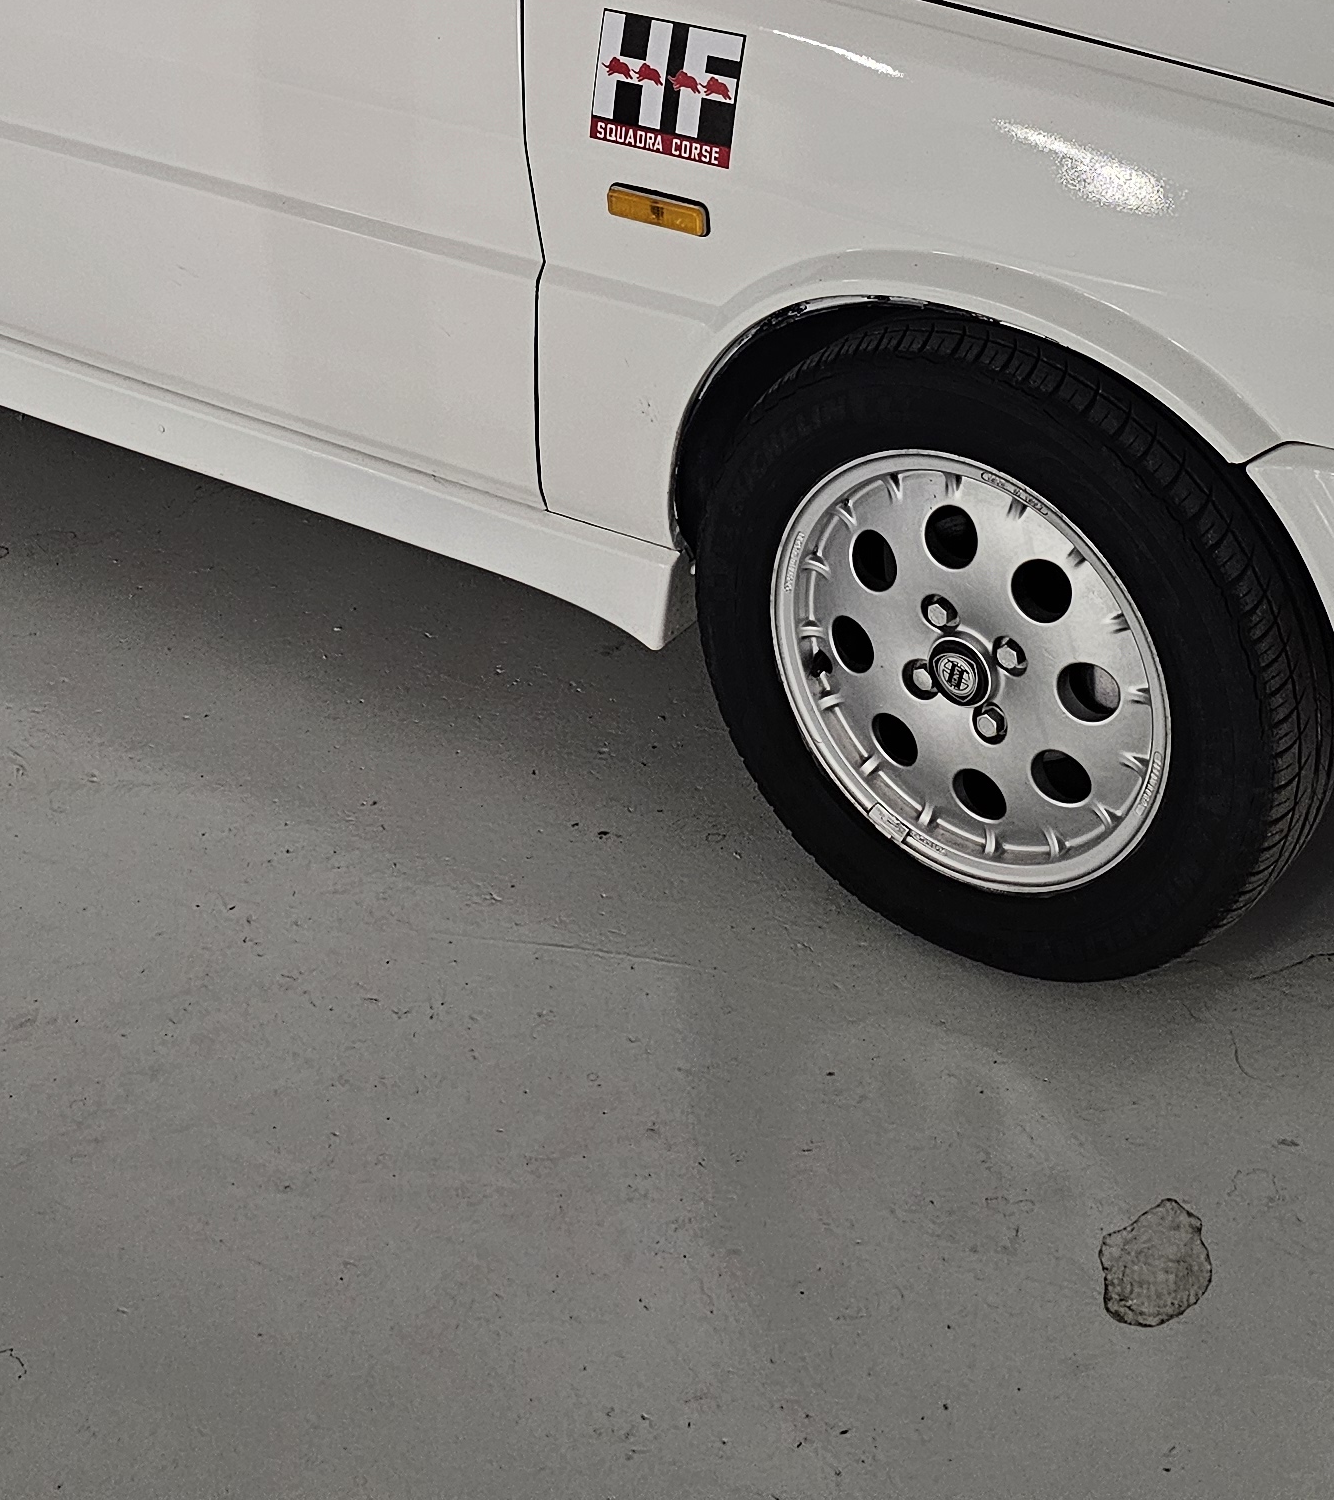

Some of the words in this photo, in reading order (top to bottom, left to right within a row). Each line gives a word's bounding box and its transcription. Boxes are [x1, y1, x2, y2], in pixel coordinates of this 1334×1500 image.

[593, 11, 744, 138] HF
[596, 121, 663, 152] SQUADRA
[671, 138, 720, 164] CORSE
